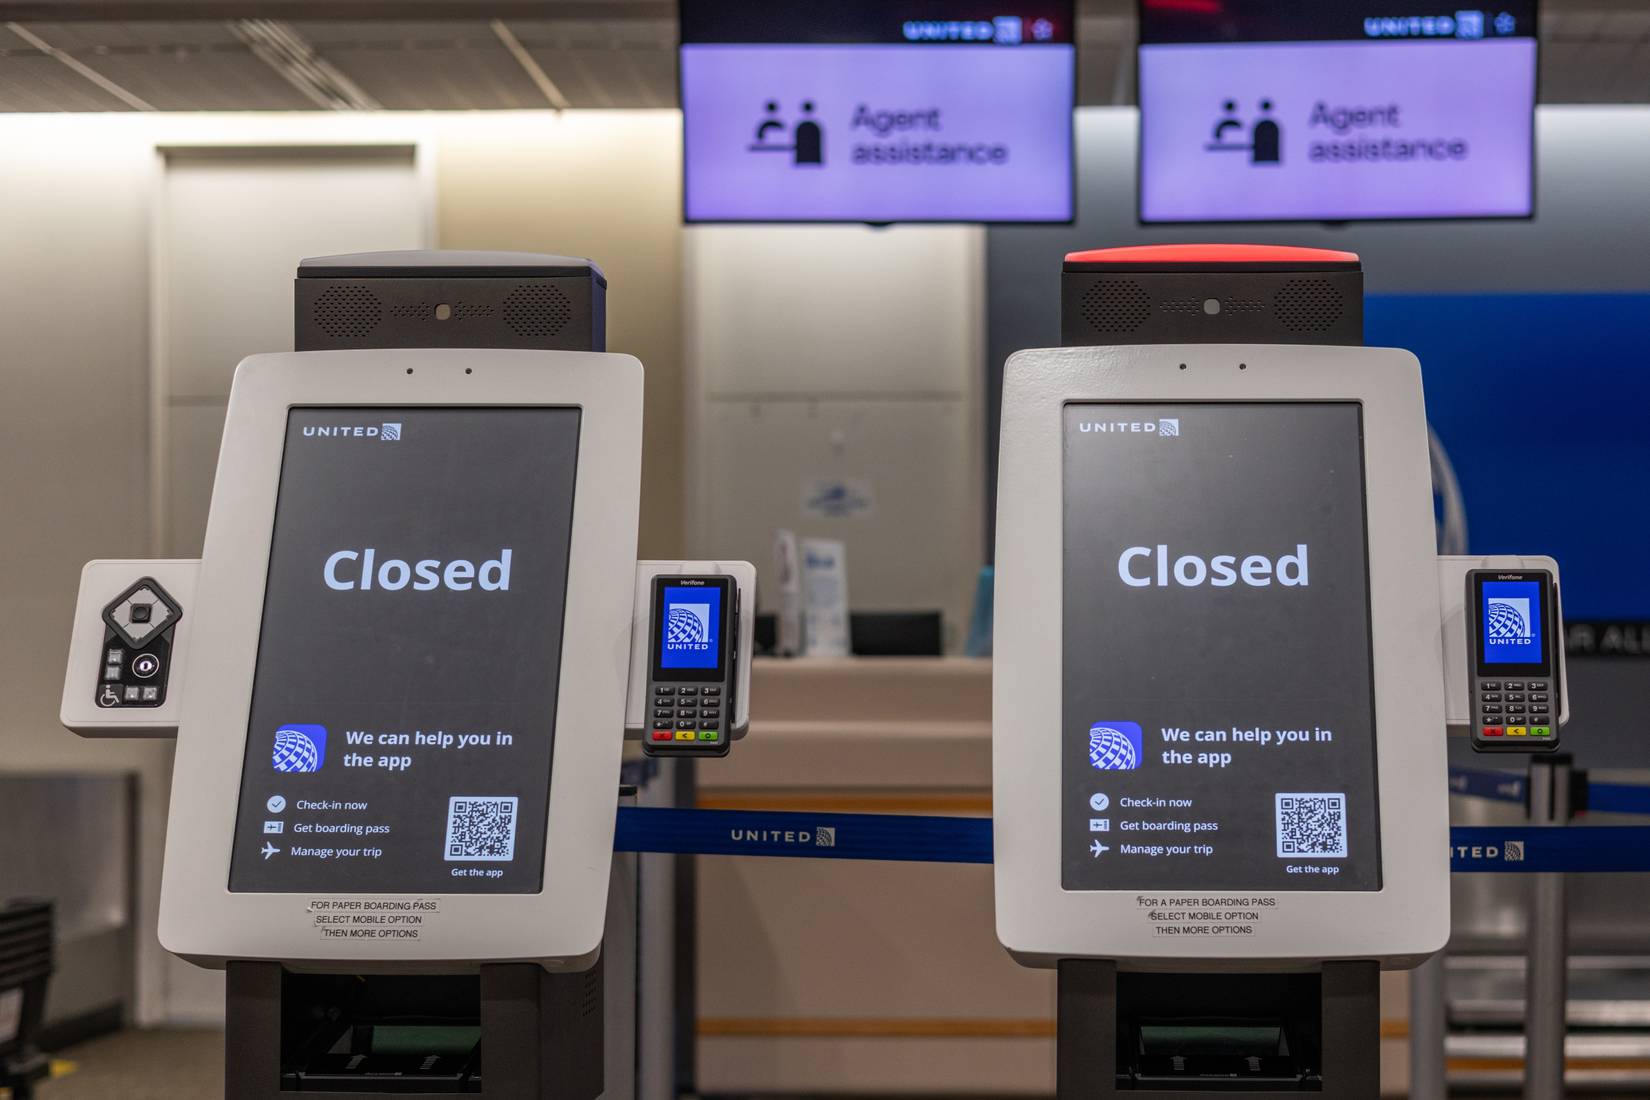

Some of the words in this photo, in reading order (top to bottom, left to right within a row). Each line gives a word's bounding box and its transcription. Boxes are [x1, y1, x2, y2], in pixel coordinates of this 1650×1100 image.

[903, 21, 994, 40] UNITED
[1364, 16, 1455, 36] UNITED
[851, 104, 941, 137] Agent
[1309, 101, 1400, 135] Agent
[851, 139, 1009, 165] assistance
[1309, 137, 1468, 162] assistance
[303, 426, 380, 437] UNITED
[1079, 422, 1156, 433] UNITED
[323, 549, 513, 591] Closed
[1117, 544, 1309, 587] Closed
[346, 731, 374, 745] We
[378, 734, 410, 745] can
[415, 731, 454, 748] help
[457, 734, 491, 748] you
[496, 731, 513, 745] in
[1161, 727, 1191, 741] We
[1195, 730, 1227, 742] can
[1232, 727, 1272, 745] help
[1276, 731, 1310, 745] you
[1315, 727, 1332, 741] in
[344, 752, 374, 767] the
[378, 756, 412, 771] app
[1162, 749, 1193, 764] the
[1197, 752, 1232, 768] app
[296, 799, 341, 810] Check-in
[344, 802, 368, 810] now
[1120, 797, 1167, 808] Check-in
[1169, 800, 1193, 808] now
[293, 823, 313, 833] Get
[315, 823, 363, 836] boarding
[366, 826, 390, 836] pass
[1120, 820, 1140, 831] Get
[1142, 820, 1191, 833] boarding
[1194, 823, 1219, 833] pass
[731, 829, 811, 843] UNITED
[291, 846, 334, 859] Manage
[336, 848, 360, 859] your
[363, 846, 382, 859] trip
[1120, 844, 1164, 857] Manage
[1166, 847, 1192, 857] your
[1194, 844, 1214, 857] trip
[1450, 846, 1499, 858] ITED
[451, 868, 467, 877] Get
[469, 868, 484, 877] the
[486, 869, 504, 879] app
[1286, 864, 1302, 874] Get
[1304, 864, 1320, 874] the
[1321, 867, 1340, 876] app
[311, 901, 330, 910] FOR
[332, 901, 362, 910] PAPER
[364, 902, 411, 911] BOARDING
[413, 901, 437, 910] PASS
[1138, 898, 1158, 907] FOR
[1160, 898, 1167, 907] A
[1169, 898, 1199, 907] PAPER
[1201, 898, 1249, 907] BOARDING
[1251, 898, 1276, 907] PASS
[315, 915, 350, 924] SELECT
[352, 915, 386, 924] MOBILE
[388, 915, 422, 924] OPTION
[1151, 911, 1186, 921] SELECT
[1188, 911, 1222, 921] MOBILE
[1224, 911, 1259, 921] OPTION
[324, 929, 347, 938] THEN
[349, 929, 377, 938] MORE
[378, 929, 418, 938] OPTIONS
[1156, 926, 1180, 935] THEN
[1182, 926, 1210, 935] MORE
[1211, 926, 1252, 935] OPTIONS
